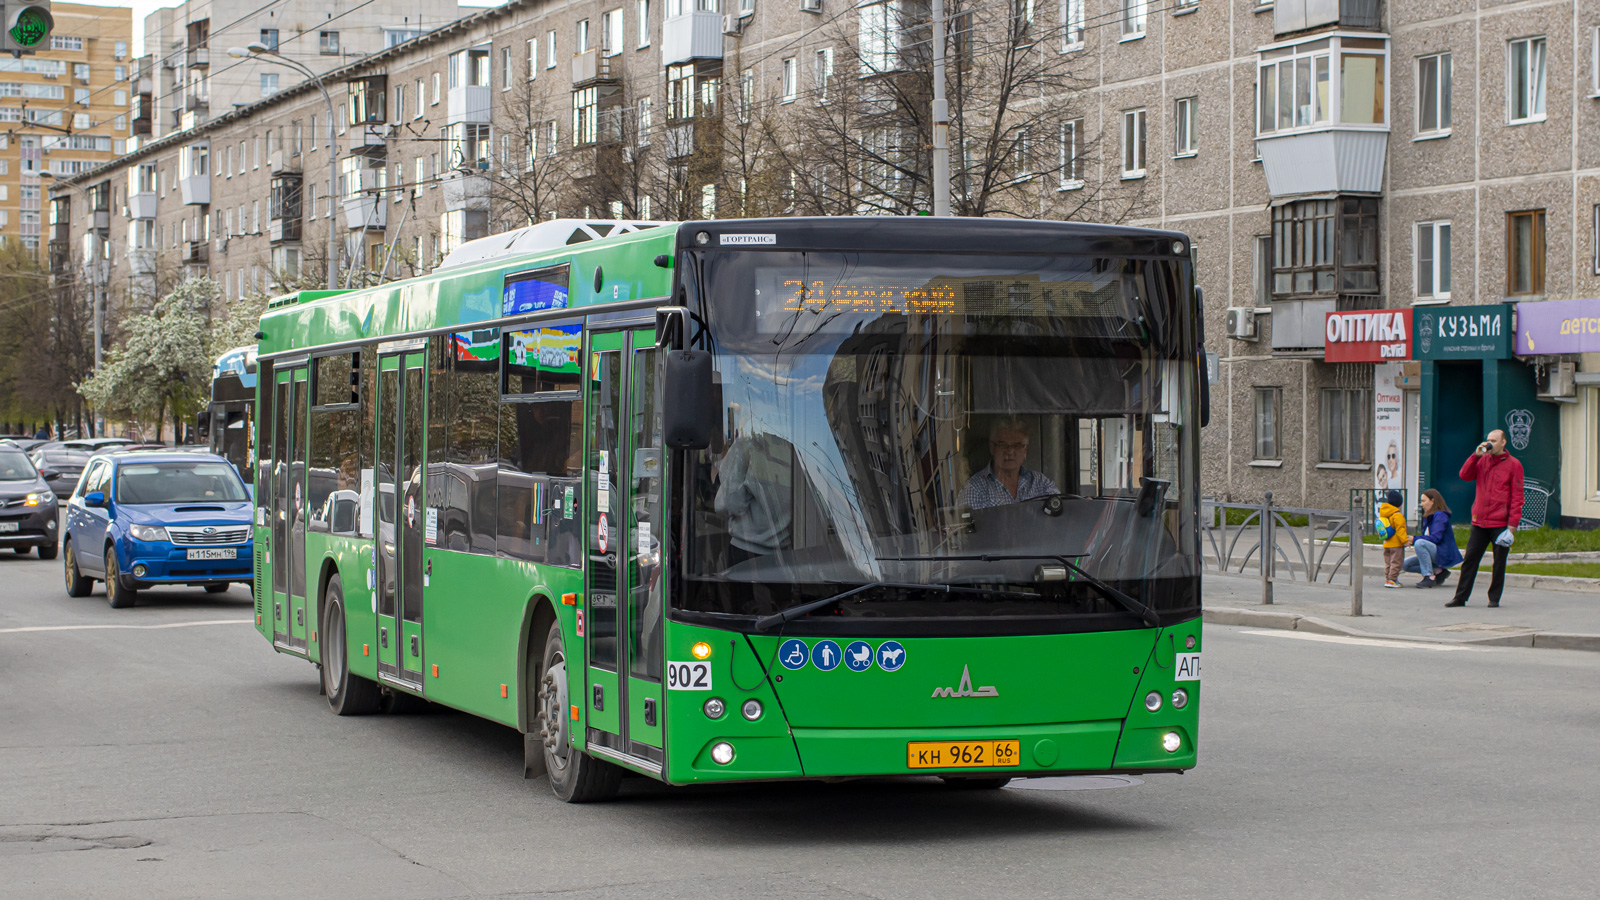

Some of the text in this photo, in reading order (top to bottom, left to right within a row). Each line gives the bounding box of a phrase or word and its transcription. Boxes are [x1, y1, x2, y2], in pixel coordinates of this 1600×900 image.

[1326, 312, 1407, 343] ОПТИКА
[1438, 314, 1501, 337] КУЗЬМА
[1376, 392, 1401, 403] Оптика
[669, 663, 708, 688] 902
[949, 745, 984, 764] 962
[995, 743, 1013, 757] 66
